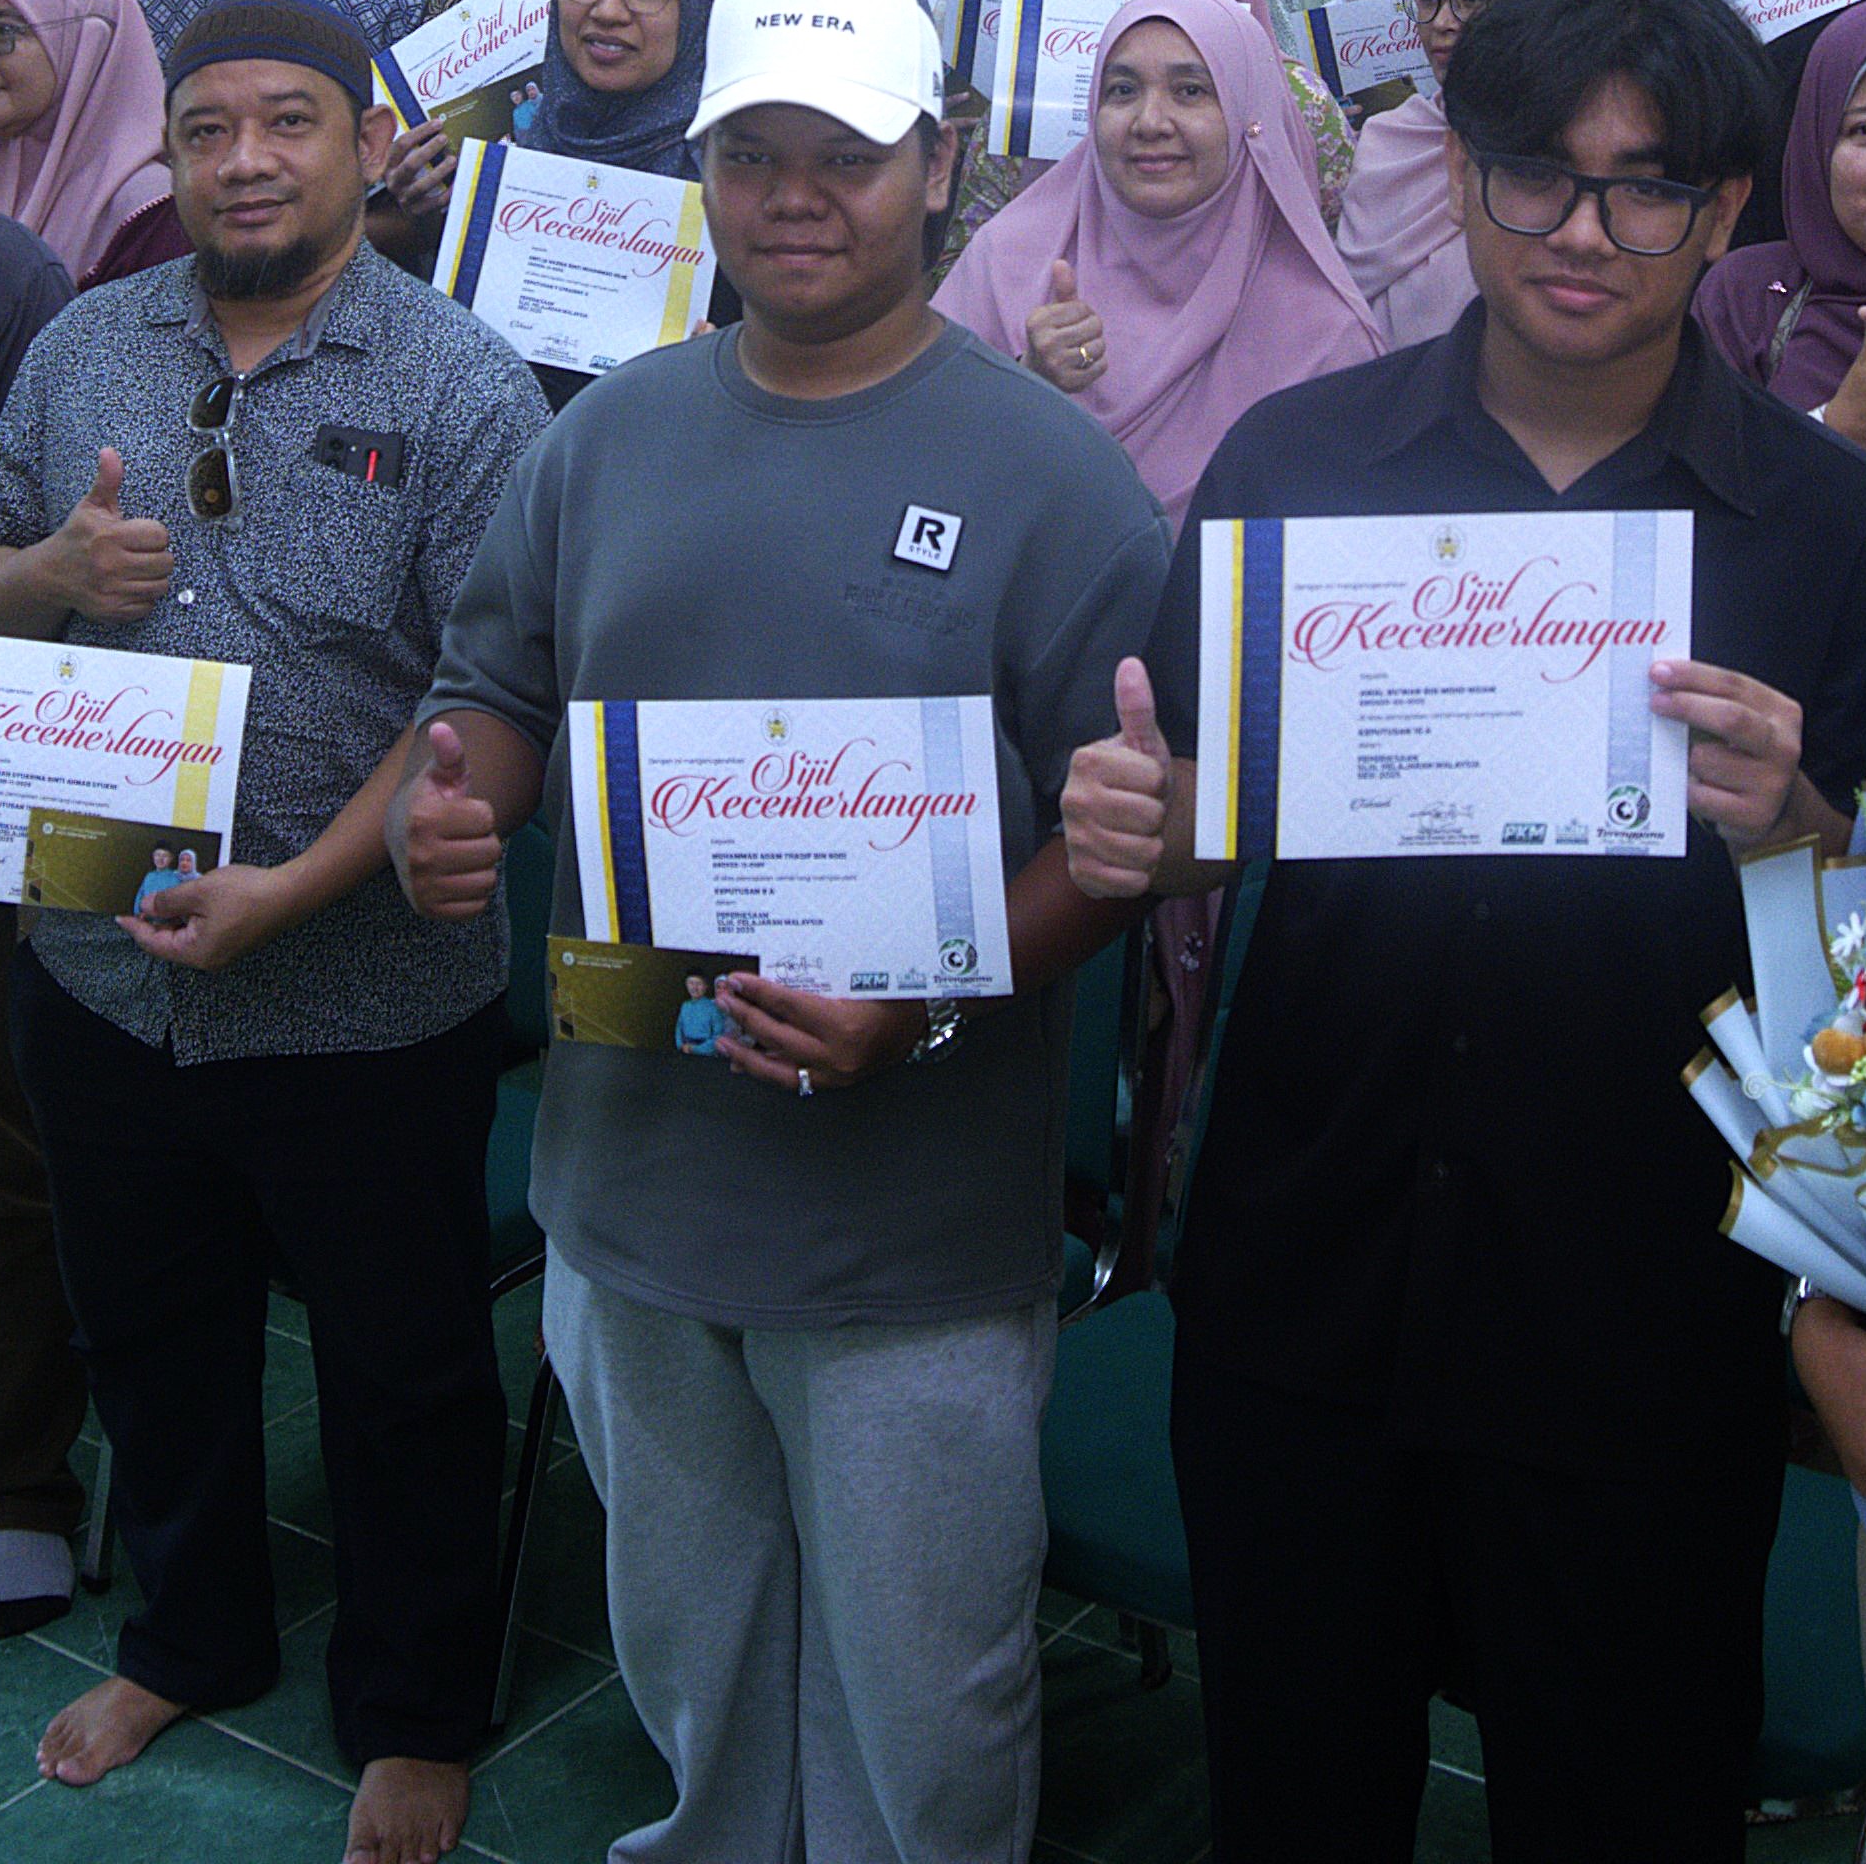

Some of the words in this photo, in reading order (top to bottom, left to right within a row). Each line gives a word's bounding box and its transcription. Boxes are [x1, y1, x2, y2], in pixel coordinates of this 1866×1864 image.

[755, 13, 803, 29] NEW
[811, 15, 856, 34] ERA
[567, 197, 652, 227] Sijil
[495, 199, 705, 277] Kecemerlangan
[909, 544, 942, 561] STYLE
[912, 516, 946, 551] R
[1413, 556, 1559, 625] Sijil
[1290, 582, 1671, 683] Kecemerlangan
[35, 686, 148, 725] Sijil
[751, 737, 876, 795] Sijil
[648, 760, 980, 851] Kecemerlangan
